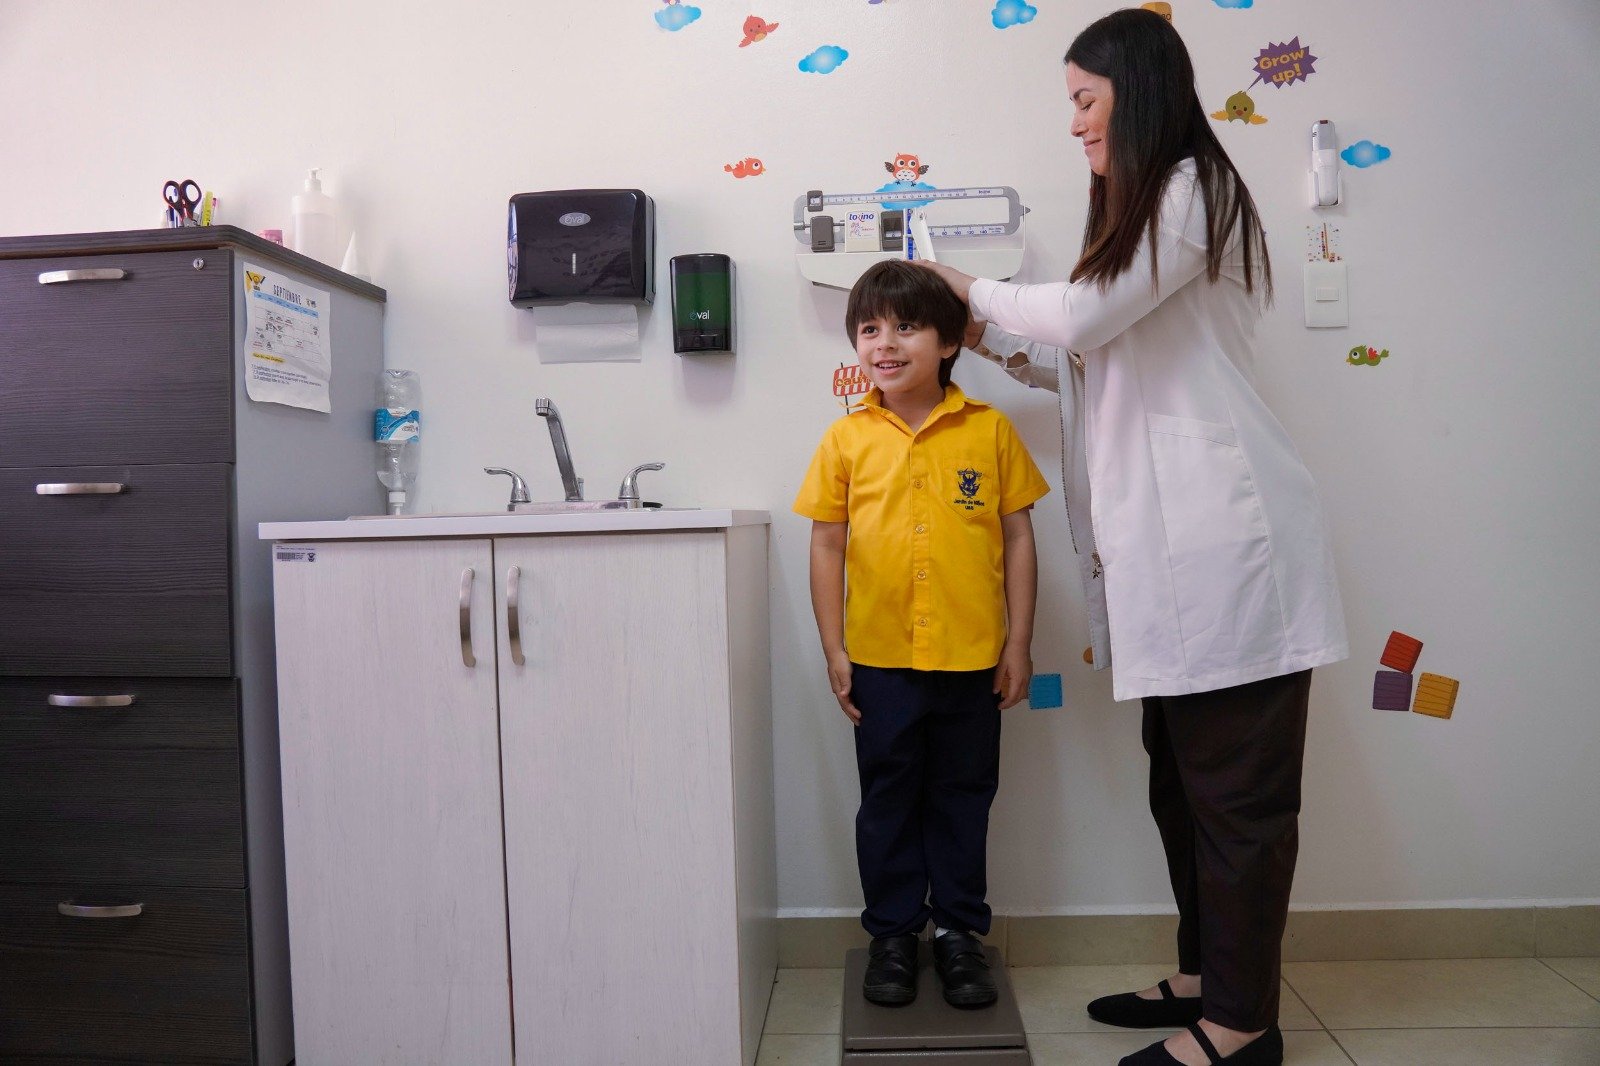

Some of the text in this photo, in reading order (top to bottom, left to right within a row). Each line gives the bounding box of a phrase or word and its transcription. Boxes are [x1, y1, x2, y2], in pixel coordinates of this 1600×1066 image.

[1260, 50, 1304, 69] Grow
[1273, 63, 1302, 82] up!
[273, 284, 302, 306] SEPTIEMBRE
[689, 310, 710, 320] oval
[835, 375, 872, 388] caut
